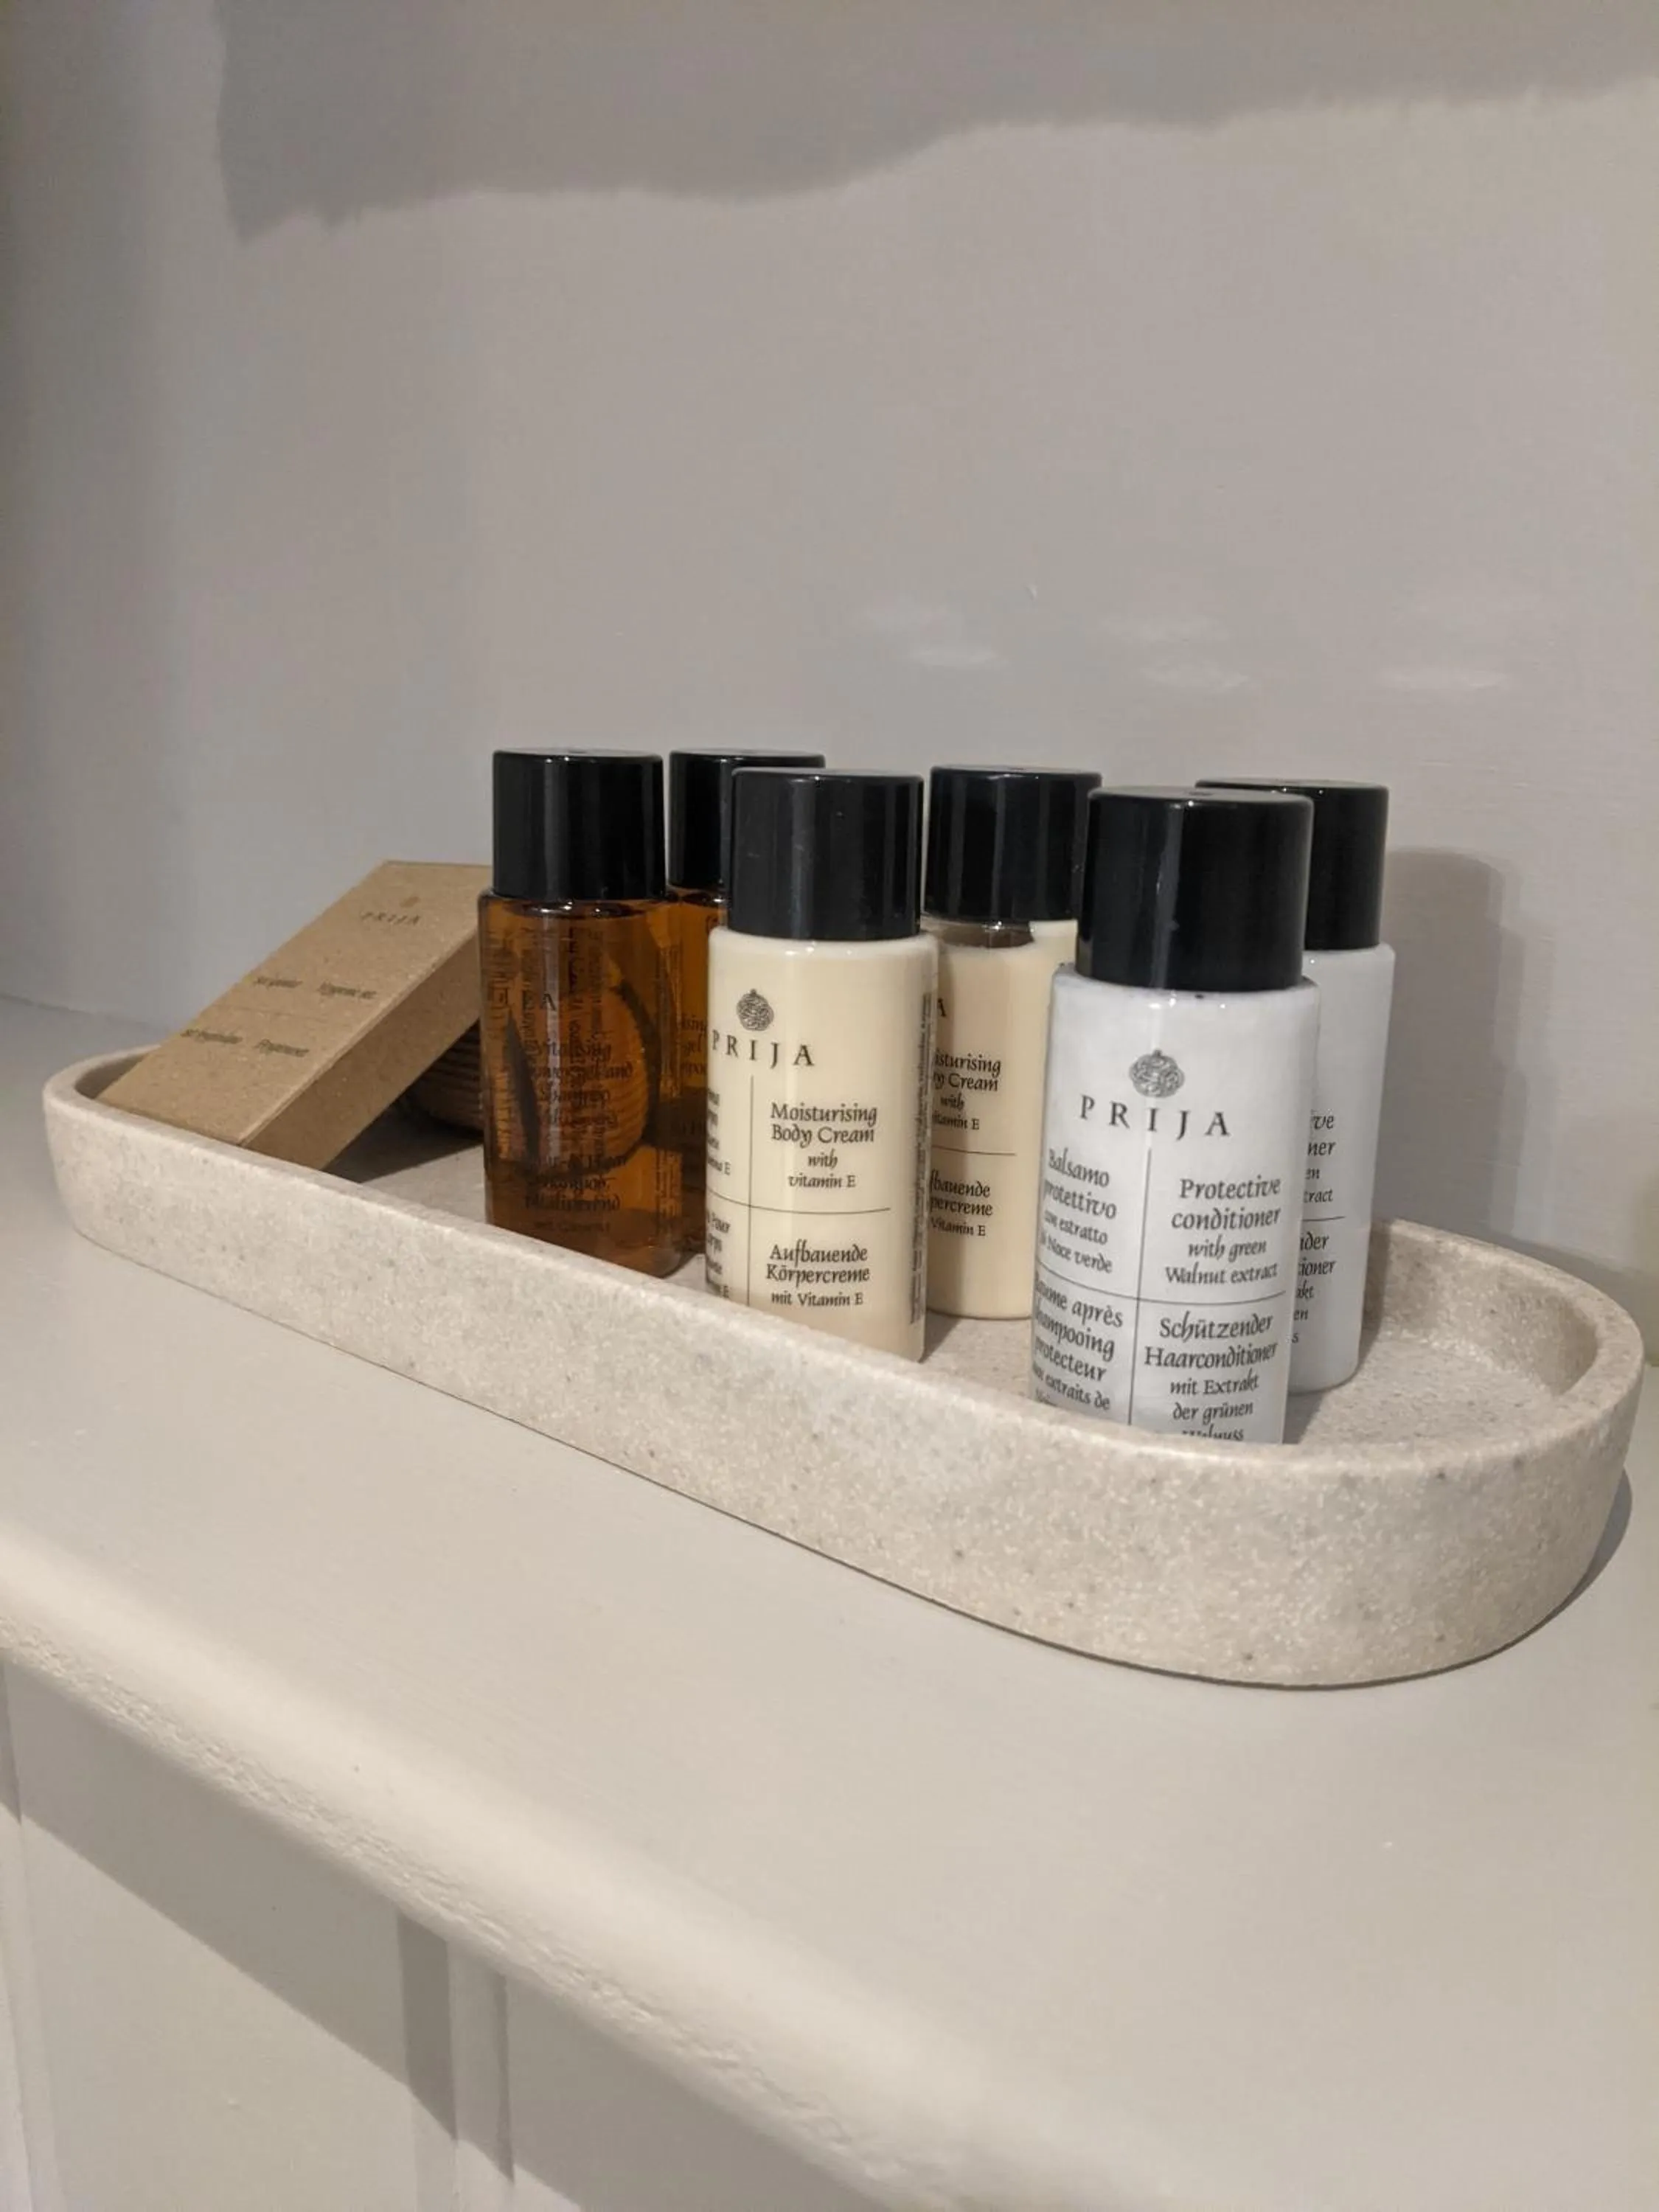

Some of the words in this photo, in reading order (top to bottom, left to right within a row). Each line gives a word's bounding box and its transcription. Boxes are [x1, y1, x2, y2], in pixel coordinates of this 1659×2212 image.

[712, 1029, 814, 1068] PRIJA
[935, 1048, 1001, 1077] isturising
[948, 1073, 998, 1091] Cream
[940, 1092, 964, 1110] with
[771, 1102, 877, 1127] Moisturising
[932, 1110, 967, 1129] itamin
[972, 1118, 980, 1130] E
[1079, 1094, 1231, 1139] PRIJA
[771, 1124, 813, 1148] Body
[818, 1127, 874, 1144] Cream
[807, 1148, 838, 1168] with
[1048, 1147, 1110, 1188] Balsamo
[787, 1173, 842, 1188] vitamin
[846, 1175, 856, 1188] E
[931, 1169, 990, 1197] fbauende
[1180, 1175, 1281, 1200] Protective
[931, 1197, 993, 1216] percreme
[1171, 1206, 1281, 1230] conditioner
[978, 1225, 986, 1237] E
[1059, 1218, 1108, 1245] estratto
[769, 1239, 868, 1268] Aufbauende
[1188, 1235, 1225, 1259] with
[1228, 1239, 1267, 1262] green
[1074, 1251, 1113, 1274] verde
[1165, 1261, 1226, 1285] Walnut
[1231, 1262, 1278, 1284] extract
[766, 1263, 870, 1288] Körpercreme
[771, 1292, 791, 1306] mit
[798, 1291, 850, 1307] Vitamin
[855, 1292, 863, 1305] E
[1072, 1300, 1123, 1328] après
[1158, 1310, 1273, 1343] Schützender
[1144, 1340, 1278, 1370] Haarconditioner
[1170, 1377, 1197, 1395] mit
[1203, 1368, 1259, 1395] Extrakt
[1094, 1390, 1110, 1409] de
[1172, 1402, 1199, 1420] der
[1202, 1402, 1254, 1426] grünen
